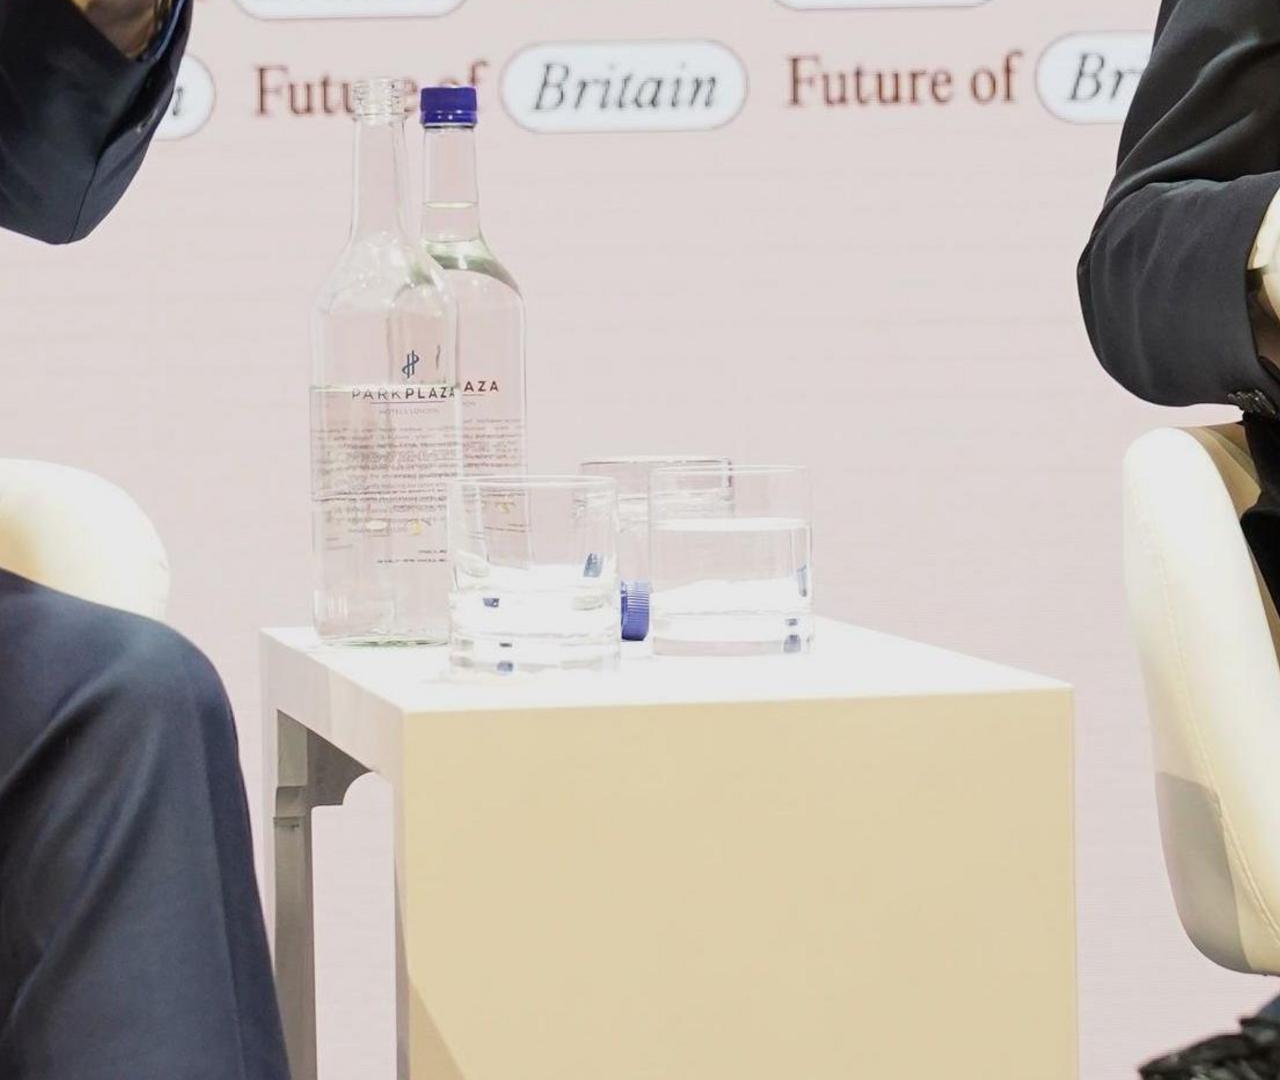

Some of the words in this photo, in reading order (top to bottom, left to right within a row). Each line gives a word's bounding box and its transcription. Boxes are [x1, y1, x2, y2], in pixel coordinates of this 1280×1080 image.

[532, 62, 717, 112] Britain
[787, 54, 954, 108] Future
[968, 49, 1026, 106] of
